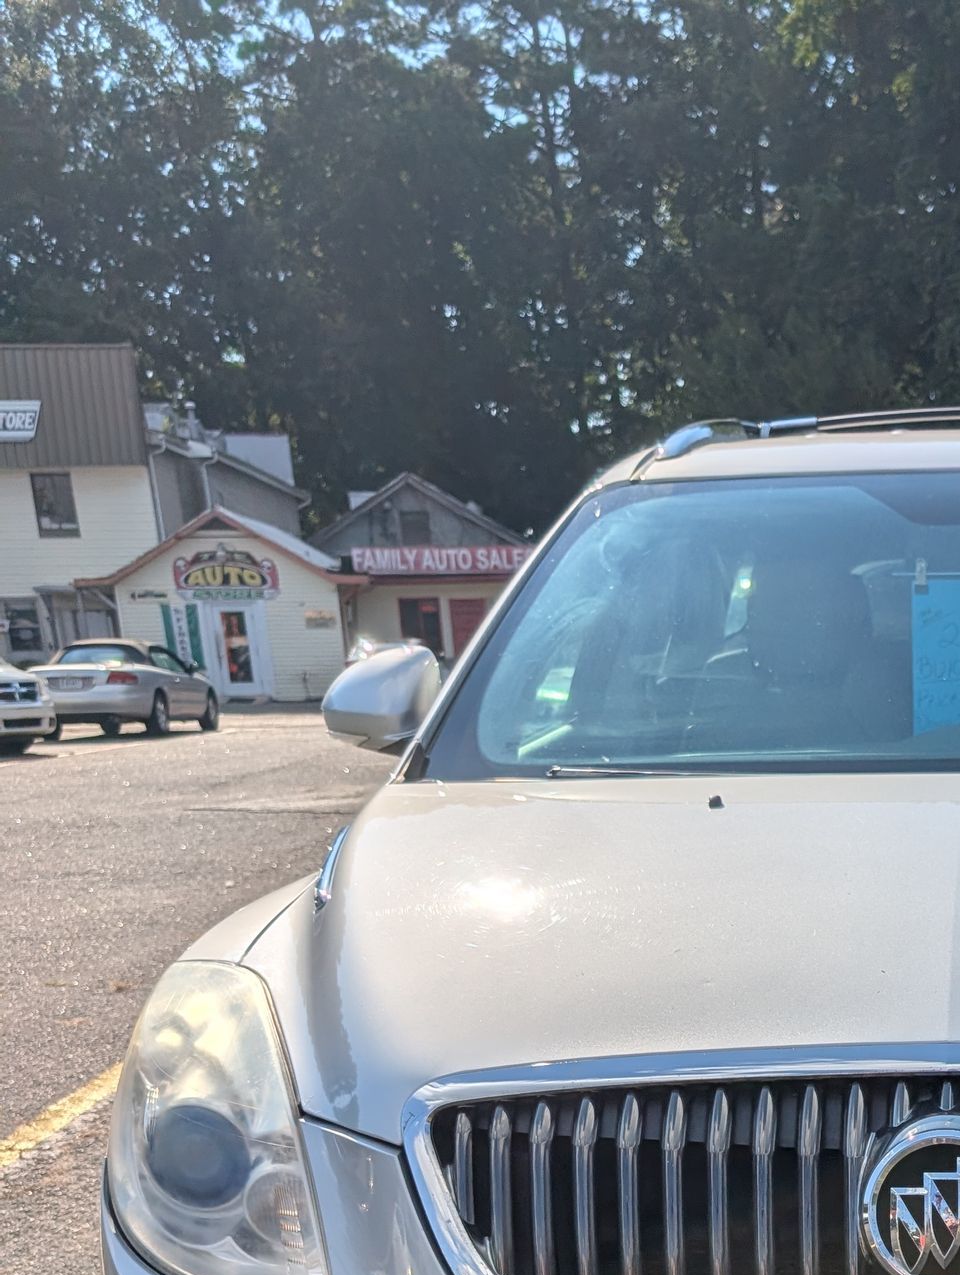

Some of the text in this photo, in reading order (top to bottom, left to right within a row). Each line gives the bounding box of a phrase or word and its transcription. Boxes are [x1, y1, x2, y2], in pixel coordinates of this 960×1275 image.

[351, 548, 533, 570] FAMILY AUTO SALE
[187, 565, 263, 587] AUTO
